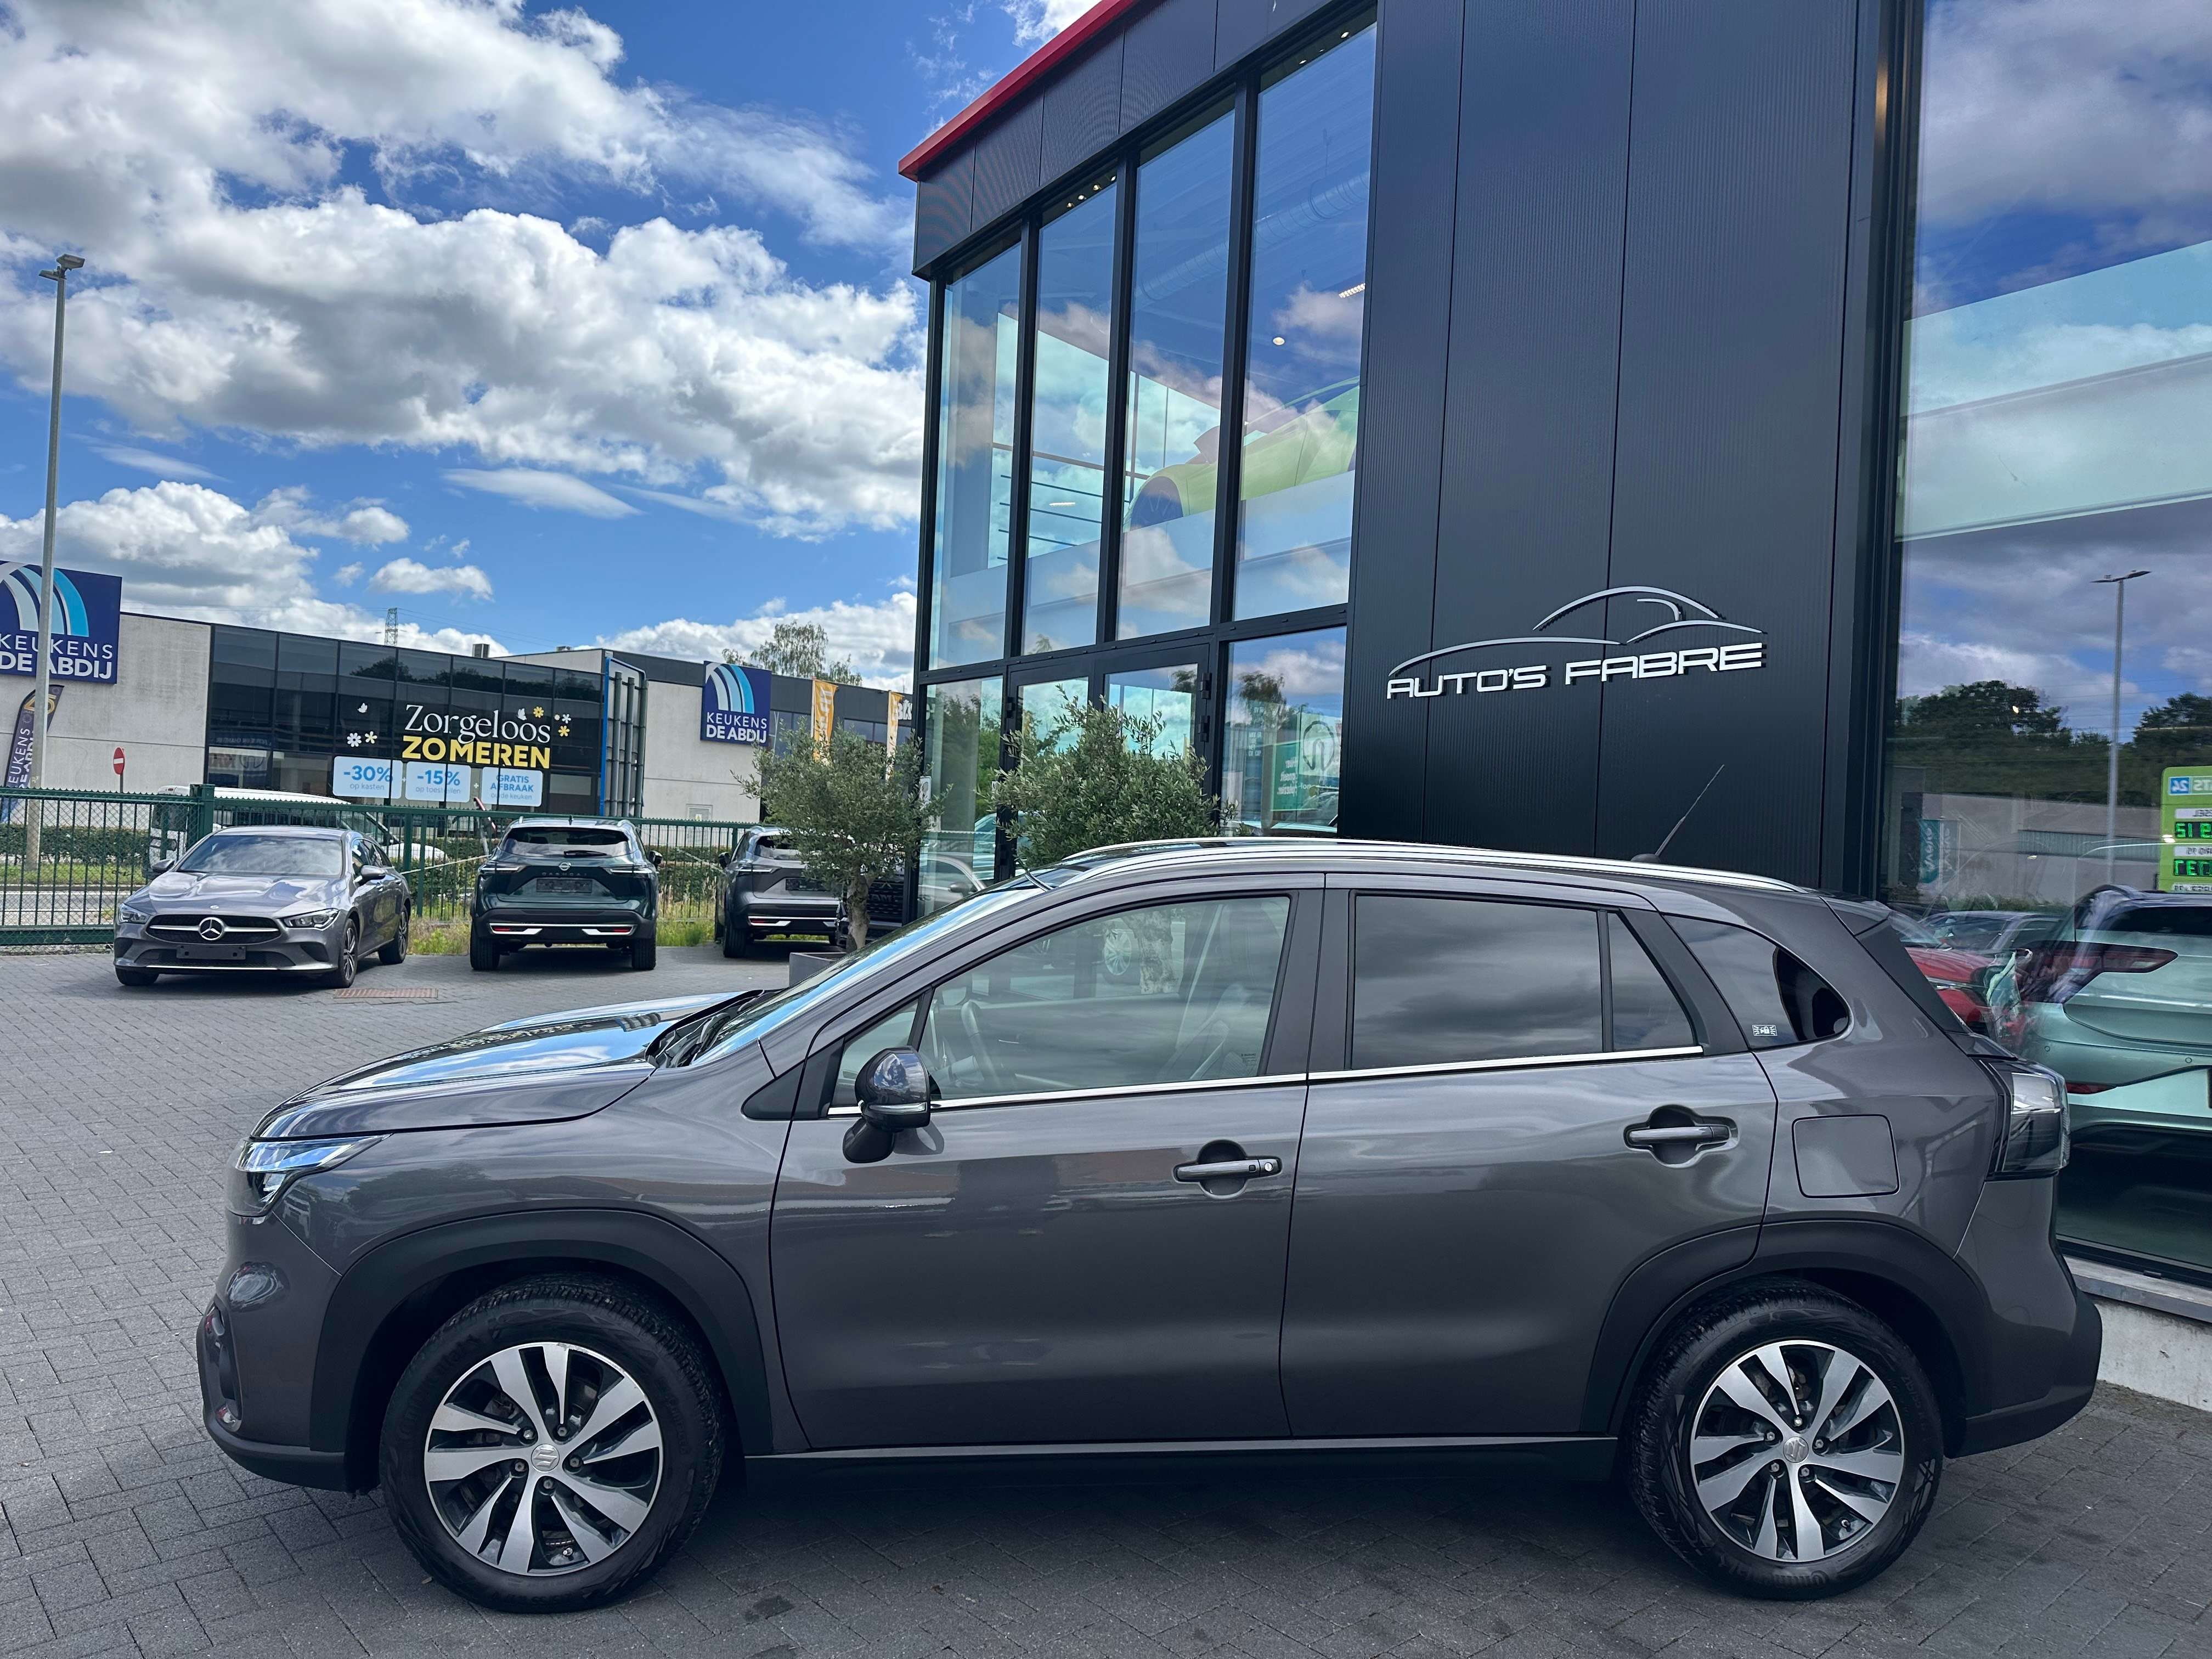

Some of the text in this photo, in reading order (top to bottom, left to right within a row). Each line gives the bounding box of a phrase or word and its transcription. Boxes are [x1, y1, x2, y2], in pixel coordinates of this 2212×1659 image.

[1386, 642, 1763, 699] AUTO'S FABRE
[404, 704, 550, 744] Zorgeloos
[707, 712, 768, 729] KEUKENS
[706, 724, 767, 743] DE ABDIJ
[8, 728, 30, 785] EUKENS
[402, 735, 550, 769] ZOMEREN
[343, 765, 393, 782] -30%
[417, 770, 460, 786] -15%
[496, 775, 529, 783] GRATIS
[361, 782, 385, 791] kasten
[490, 782, 534, 792] AFBRAAK
